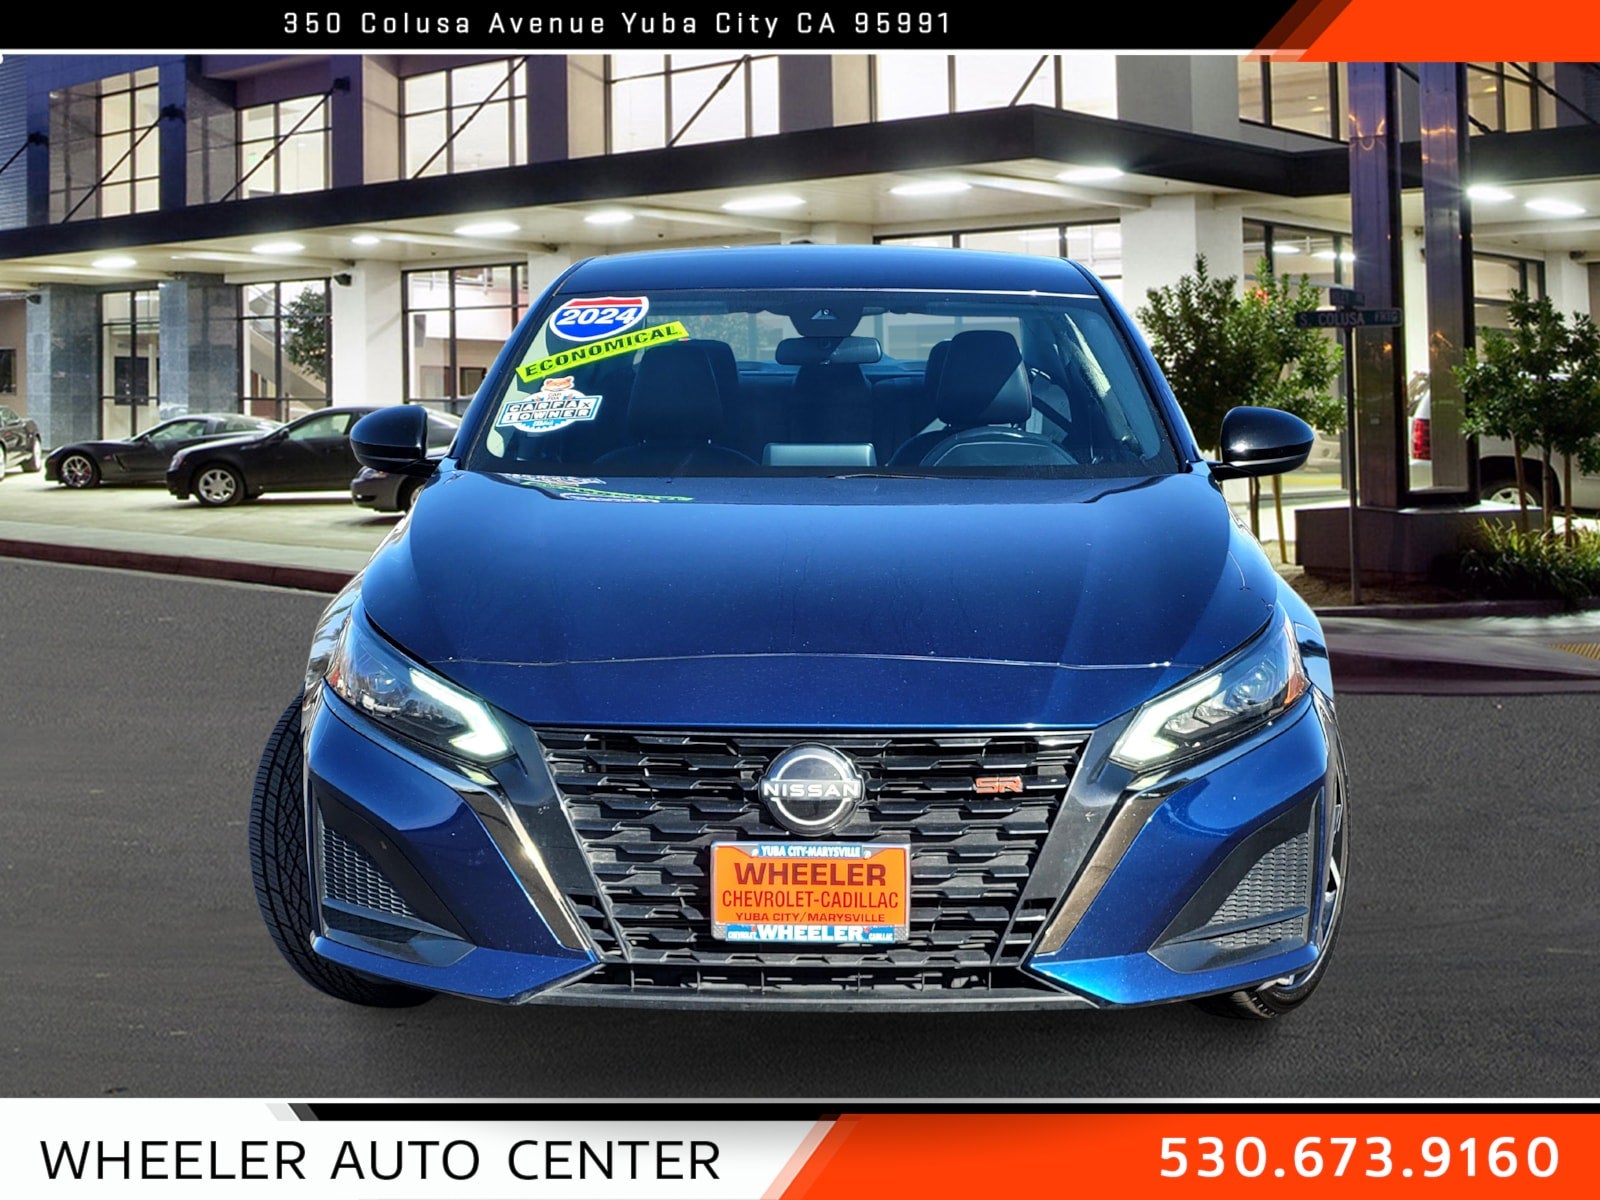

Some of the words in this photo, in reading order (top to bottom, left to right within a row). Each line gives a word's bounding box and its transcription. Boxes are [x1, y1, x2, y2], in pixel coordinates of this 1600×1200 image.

[556, 308, 637, 326] 2024
[1318, 312, 1365, 326] COLUSA
[525, 326, 679, 376] ECONOMICAL
[507, 400, 592, 413] CARFAX
[518, 409, 591, 420] OWNER
[764, 783, 859, 797] NISSAN
[975, 777, 1022, 793] SR
[761, 845, 785, 857] YUBA
[788, 845, 860, 858] CITY-MARYSVILLE
[734, 862, 887, 886] WHEELER
[722, 890, 899, 909] CHEVROLET-CADILLAC
[736, 912, 770, 922] YUBA
[772, 912, 886, 923] CITY/MARYSVILLE
[756, 924, 864, 942] WHEELER
